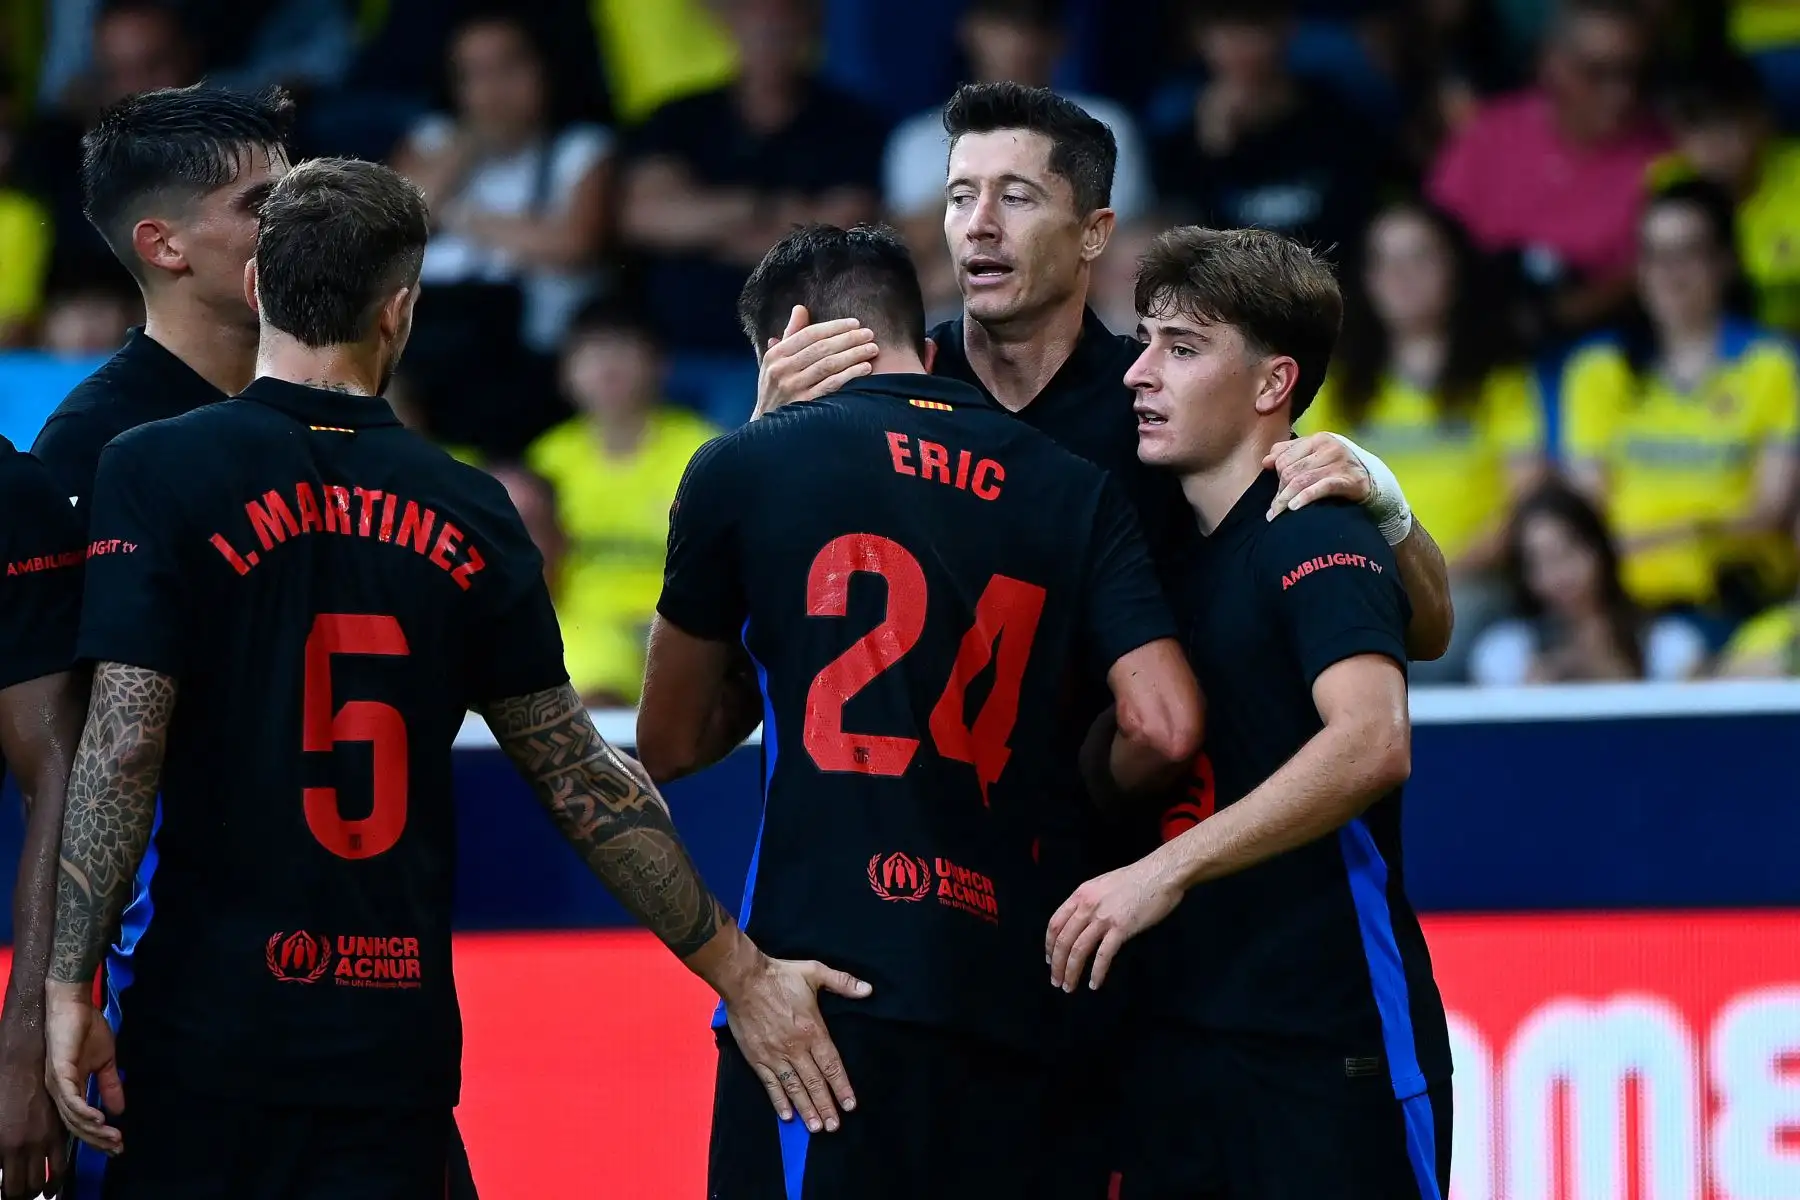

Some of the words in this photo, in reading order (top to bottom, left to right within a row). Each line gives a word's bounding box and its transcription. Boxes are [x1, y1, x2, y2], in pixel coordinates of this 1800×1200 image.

[885, 431, 1005, 501] ERIC
[122, 541, 138, 553] tv
[1281, 552, 1366, 590] AMBILIGHT
[803, 533, 1046, 806] 24
[303, 613, 410, 860] 5
[935, 857, 995, 896] UNHCR
[937, 878, 998, 915] ACNUR
[337, 935, 419, 957] UNHCR
[334, 957, 421, 979] ACNUR
